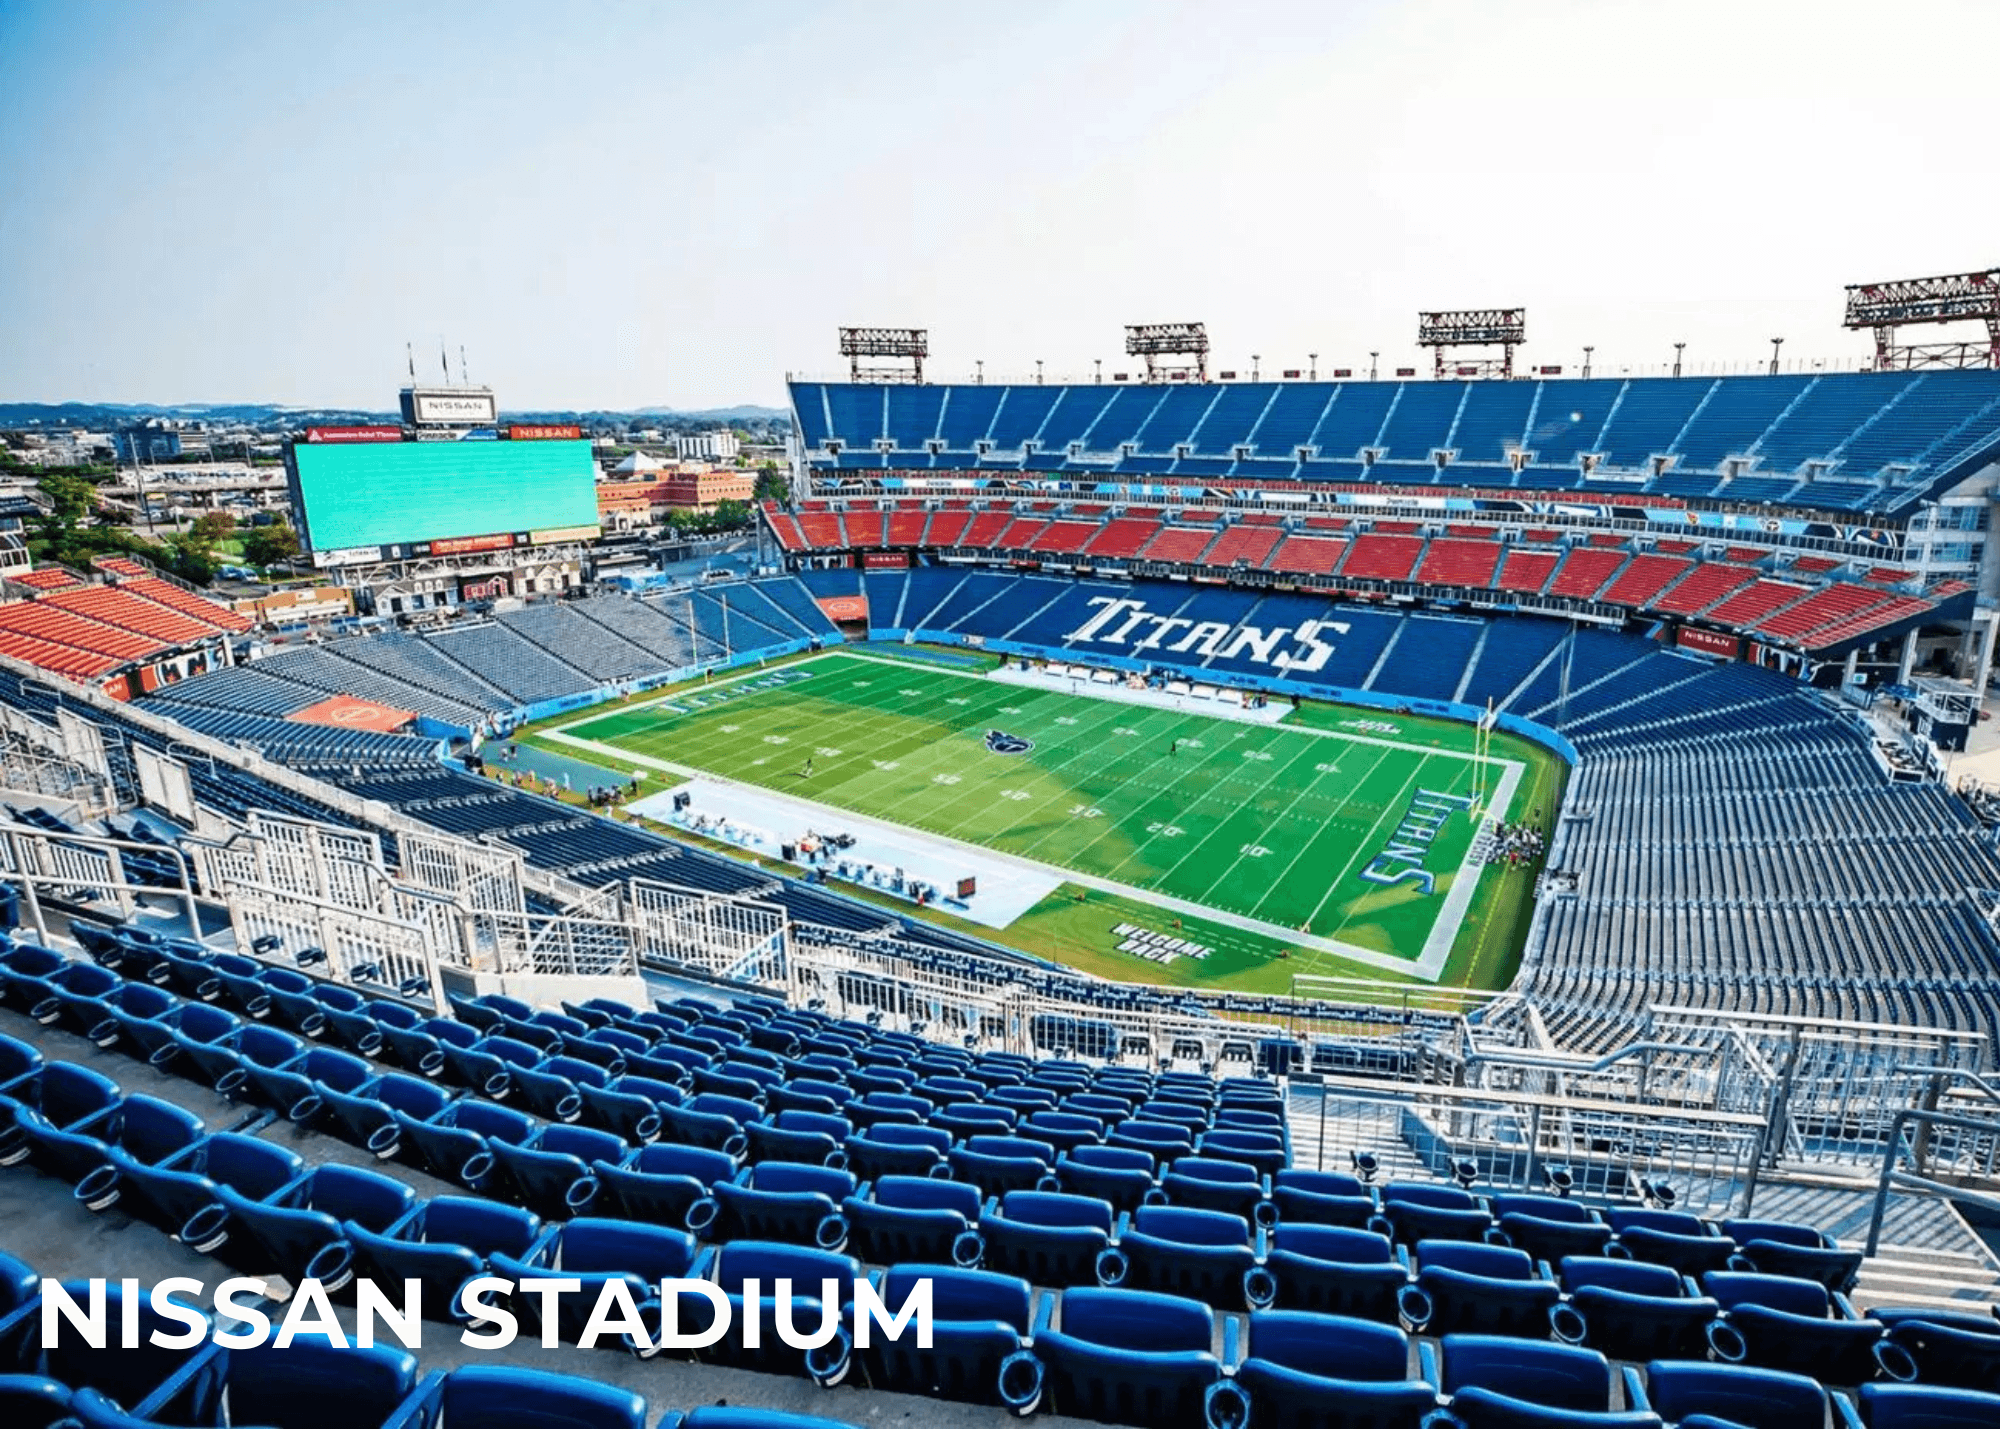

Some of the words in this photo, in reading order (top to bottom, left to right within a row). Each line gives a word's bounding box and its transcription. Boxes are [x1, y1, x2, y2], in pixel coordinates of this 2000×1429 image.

[429, 401, 482, 410] NISSAN
[520, 427, 573, 438] NISSAN
[868, 555, 904, 563] NISSAN
[1684, 630, 1730, 647] NISSAN
[1358, 787, 1480, 895] TITANS
[1110, 921, 1217, 960] WELCOME
[1114, 937, 1181, 965] BACK
